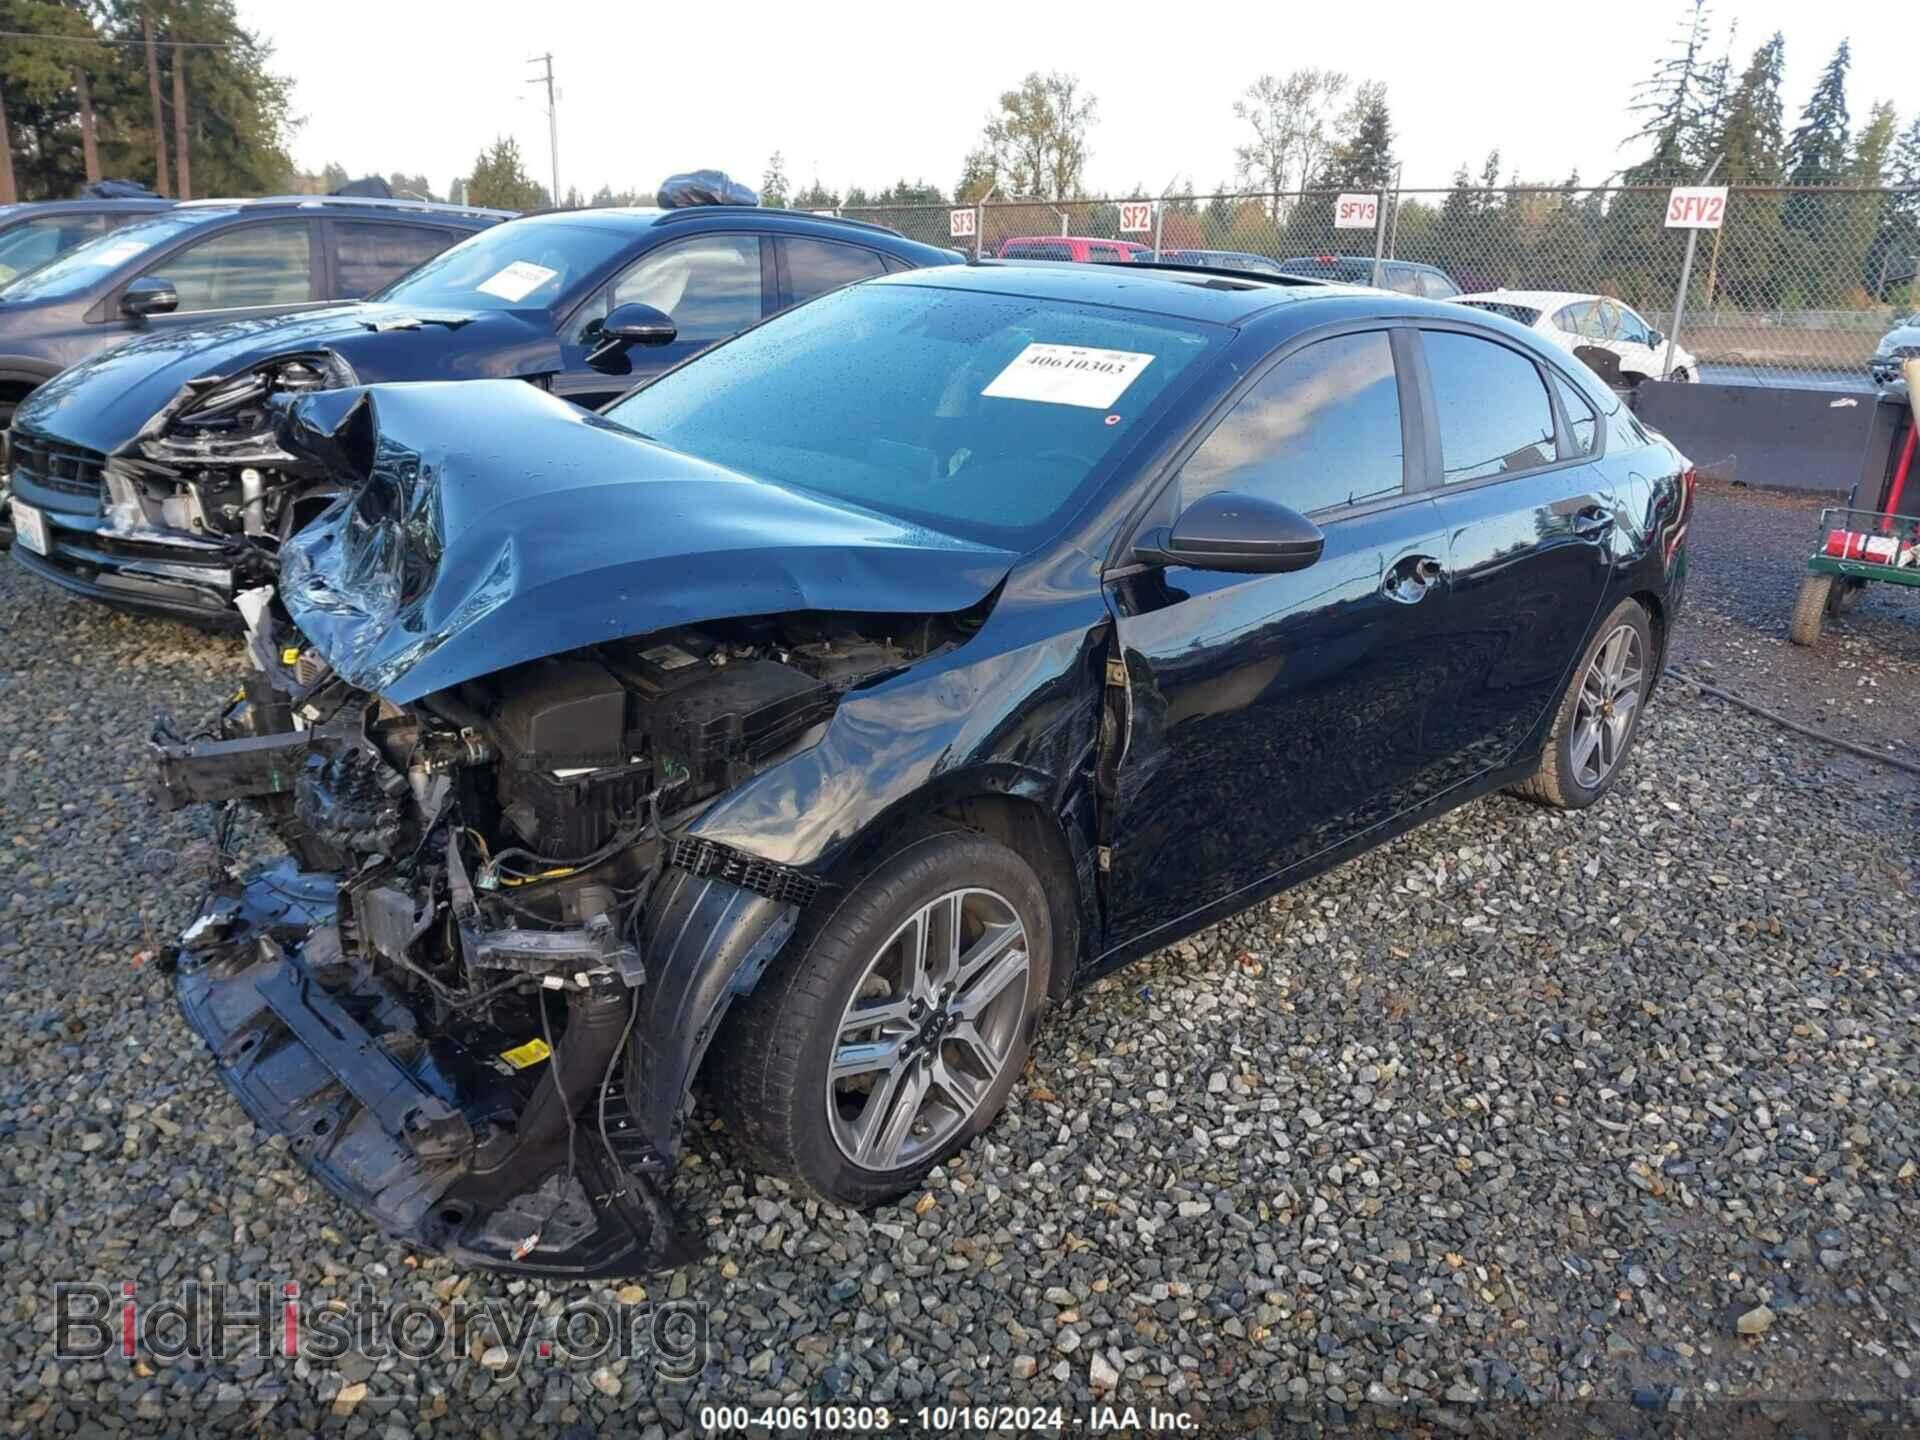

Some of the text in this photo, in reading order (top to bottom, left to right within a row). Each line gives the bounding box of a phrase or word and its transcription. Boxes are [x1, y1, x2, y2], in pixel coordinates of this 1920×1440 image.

[1123, 205, 1148, 228] SF2
[1340, 203, 1376, 219] SFV3
[1670, 196, 1723, 221] SFV2
[952, 212, 975, 233] SF3
[1027, 355, 1125, 375] 40610303
